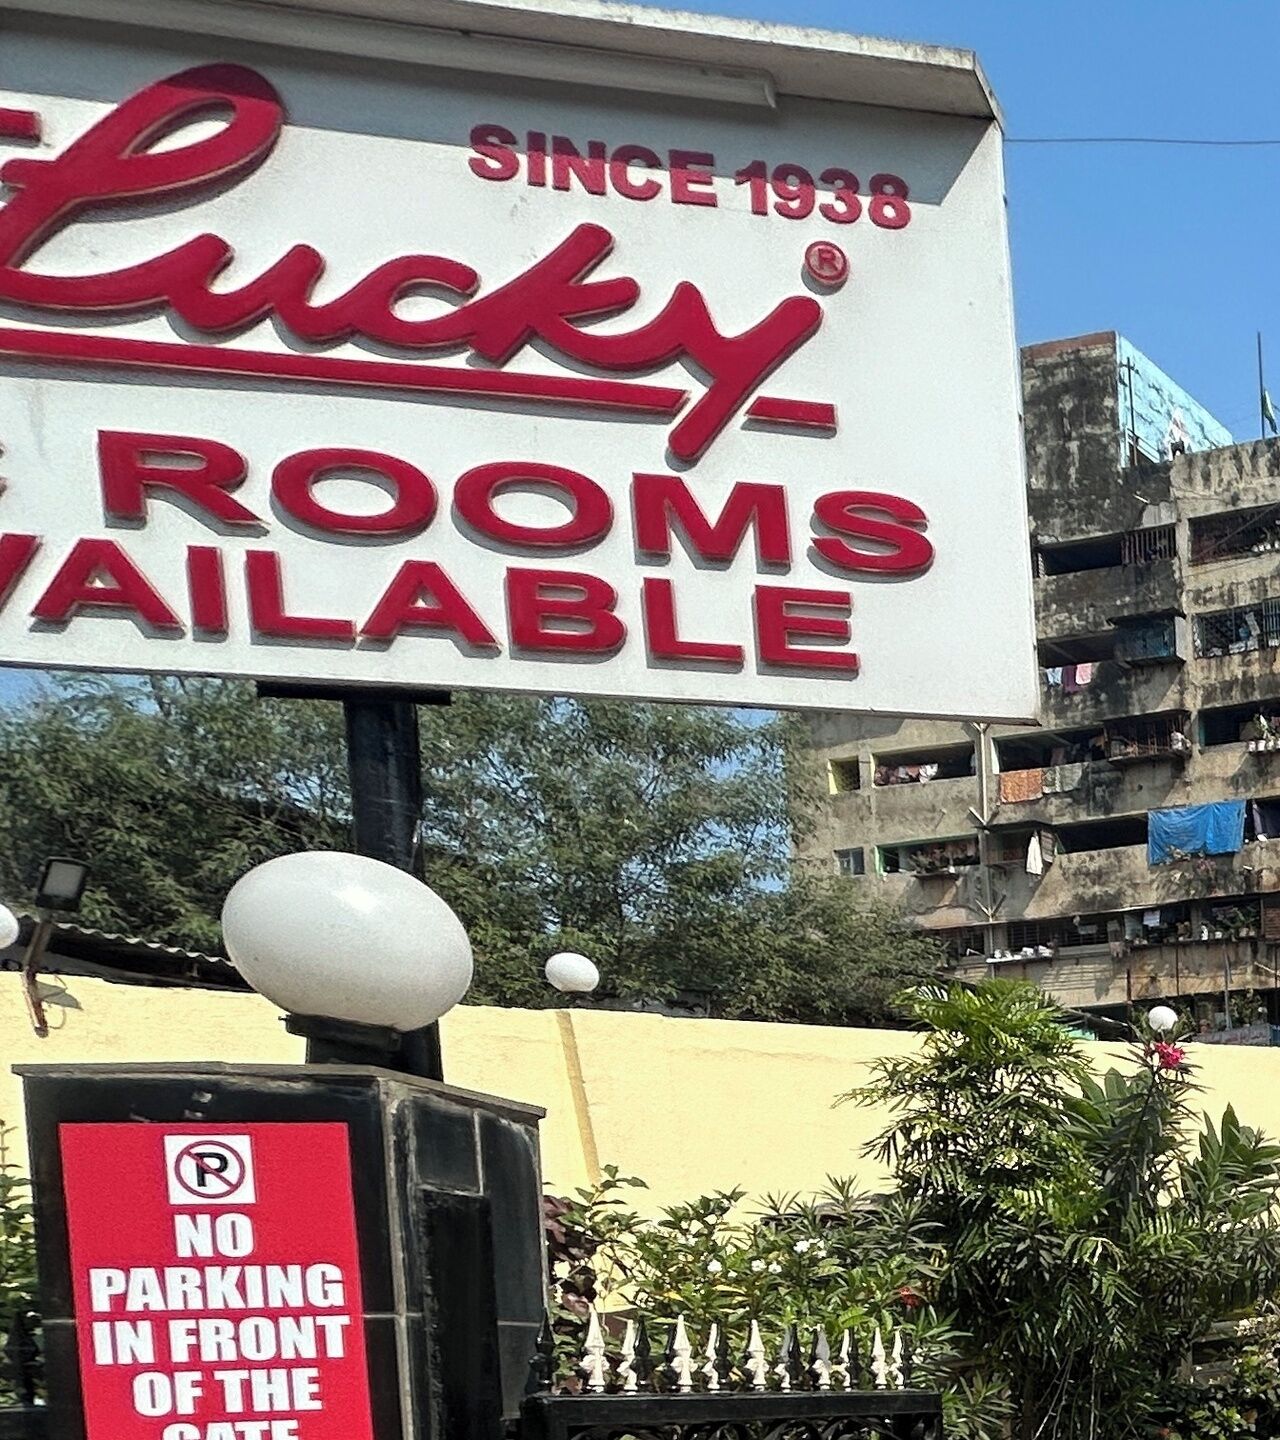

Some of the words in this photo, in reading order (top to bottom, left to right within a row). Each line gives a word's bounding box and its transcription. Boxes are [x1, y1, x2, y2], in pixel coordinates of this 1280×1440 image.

[469, 124, 719, 208] SINCE
[735, 158, 912, 230] 1938
[97, 429, 935, 577] ROOMS
[174, 1212, 255, 1258] NO
[88, 1263, 345, 1312] PARKING
[92, 1319, 156, 1365] IN
[169, 1314, 352, 1363] FRONT
[132, 1370, 205, 1417] OF
[214, 1367, 323, 1414] THE
